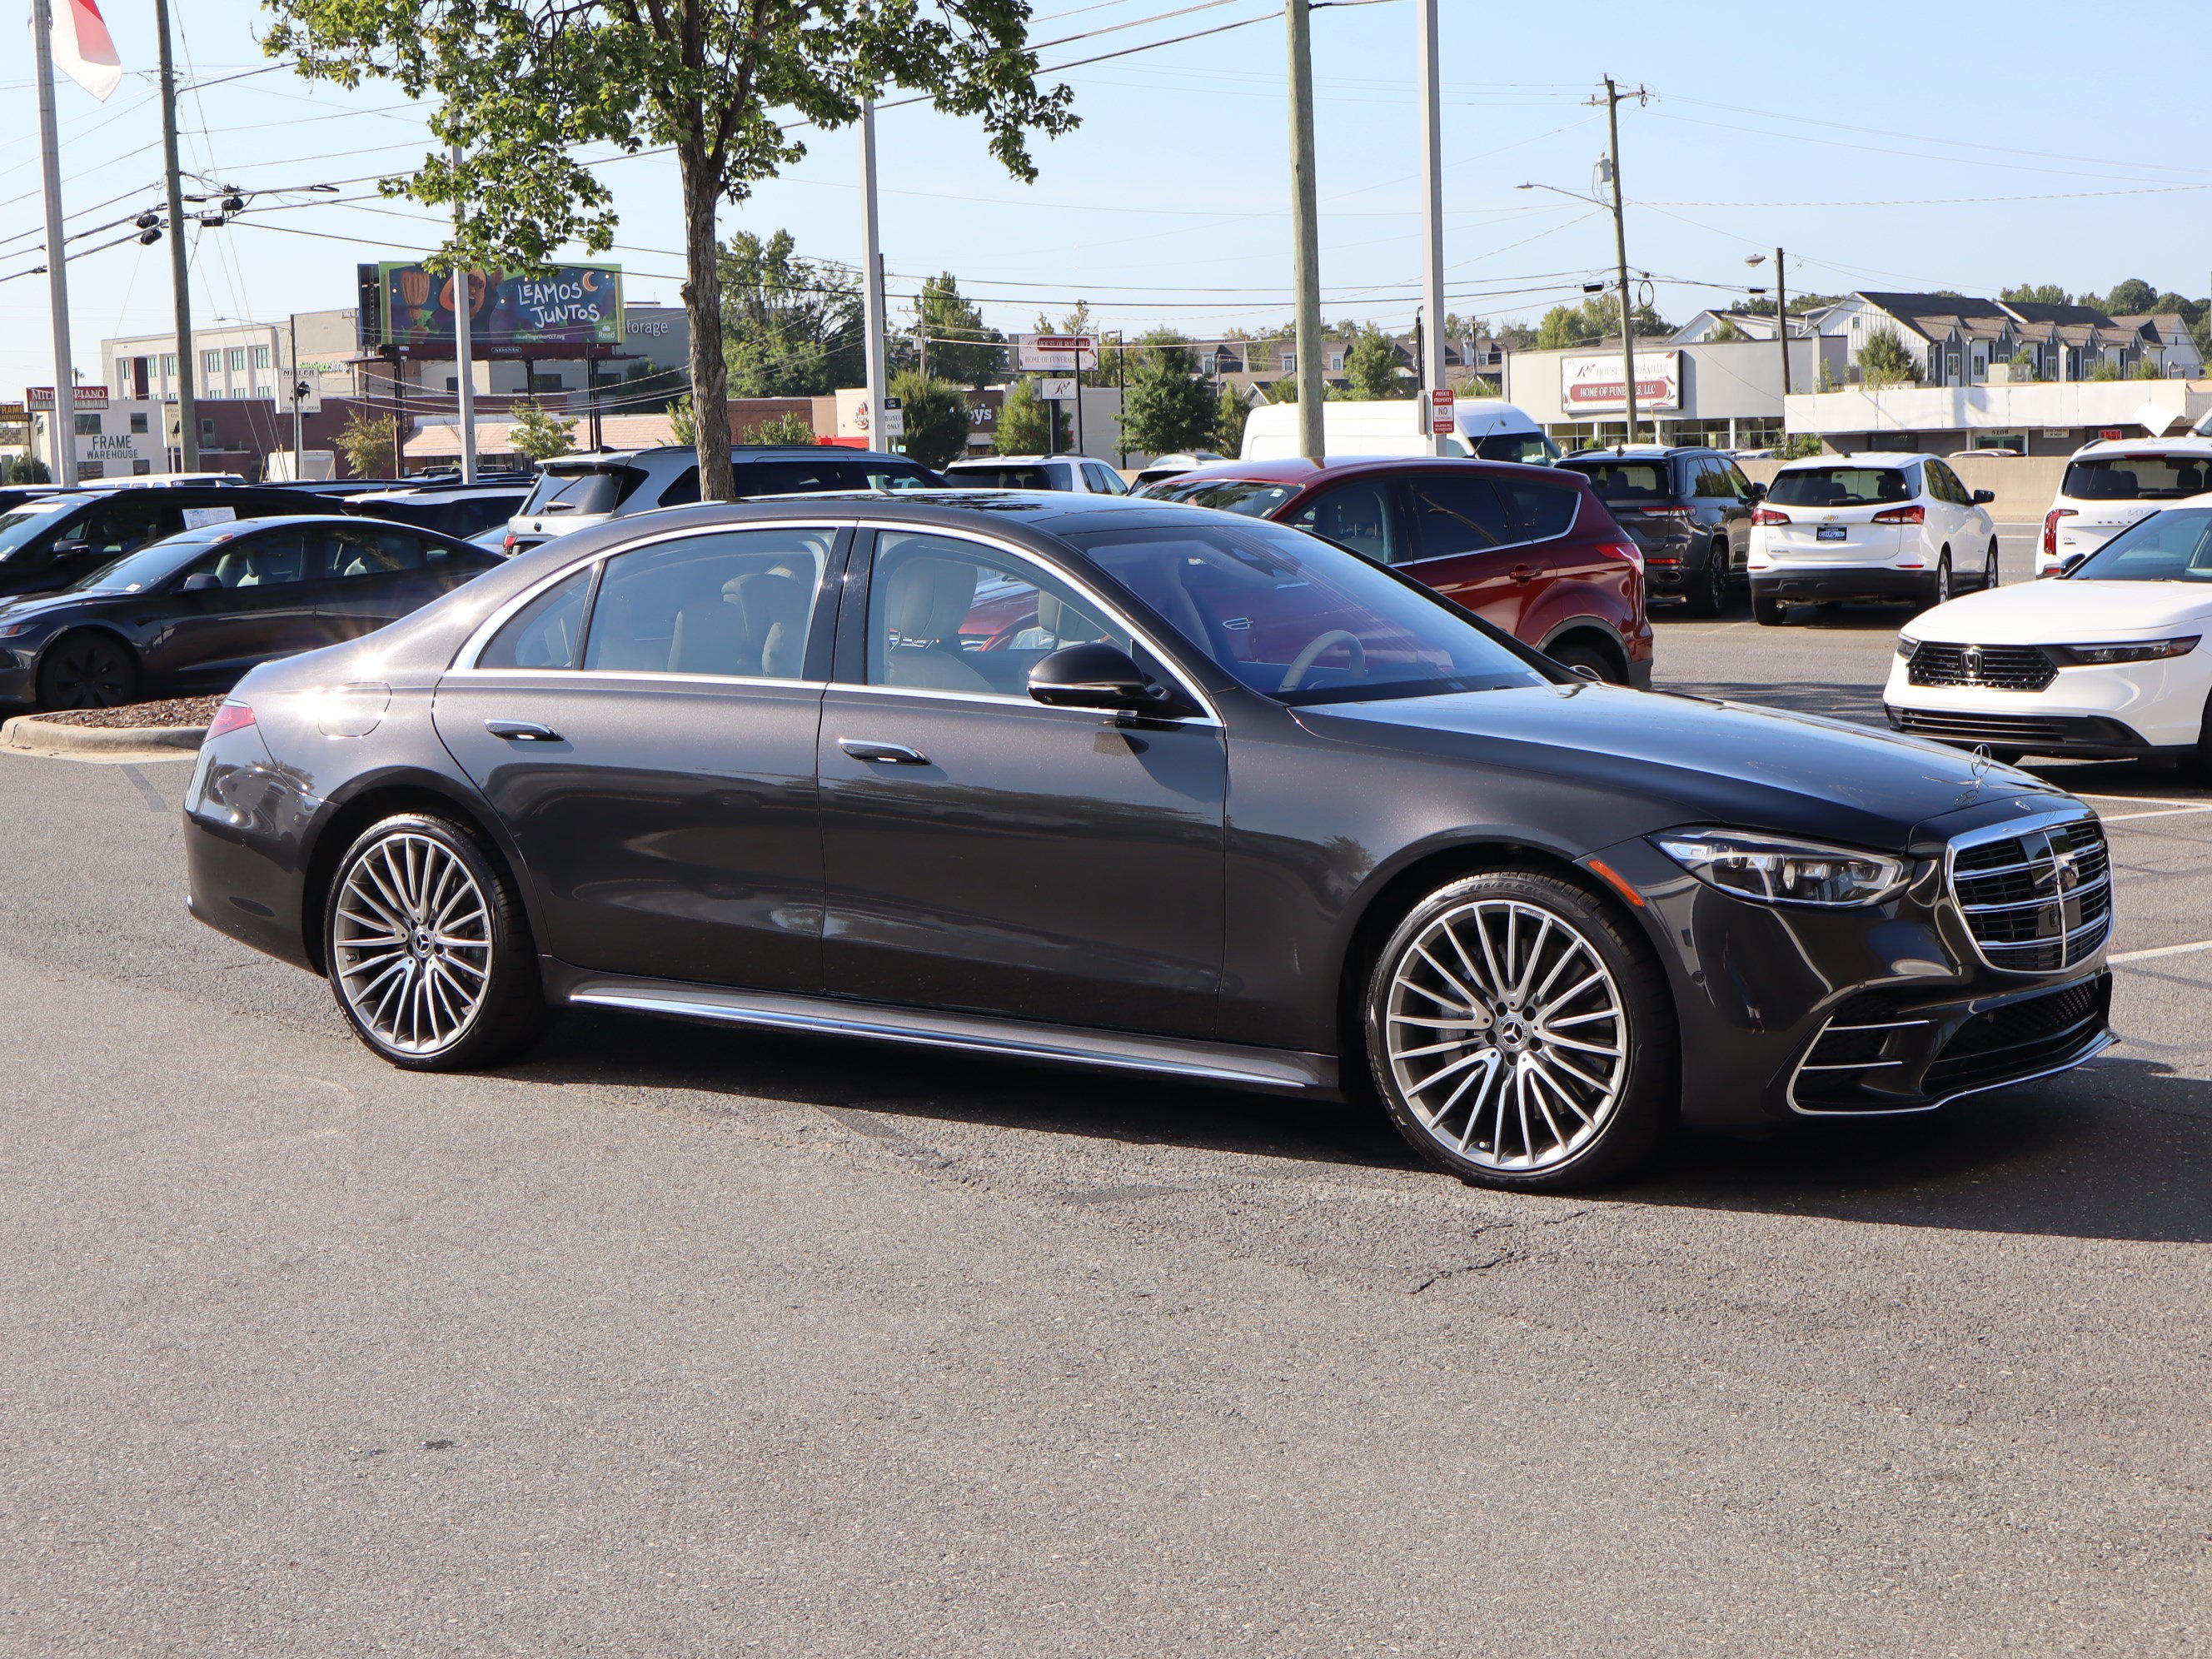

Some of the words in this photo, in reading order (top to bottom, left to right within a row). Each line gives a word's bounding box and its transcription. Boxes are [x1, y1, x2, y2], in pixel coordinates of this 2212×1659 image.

[518, 282, 583, 306] LEAMOS
[529, 303, 600, 329] JUNTOS
[625, 319, 669, 337] torage
[598, 331, 615, 340] Read
[1596, 366, 1619, 376] HOUSE
[1580, 387, 1598, 397] HOME
[1599, 386, 1608, 396] OF
[1644, 384, 1657, 395] LLC
[0, 405, 24, 414] RAME
[1438, 406, 1448, 416] NO
[92, 435, 132, 451] FRAME
[87, 449, 138, 460] WAREHOUSE
